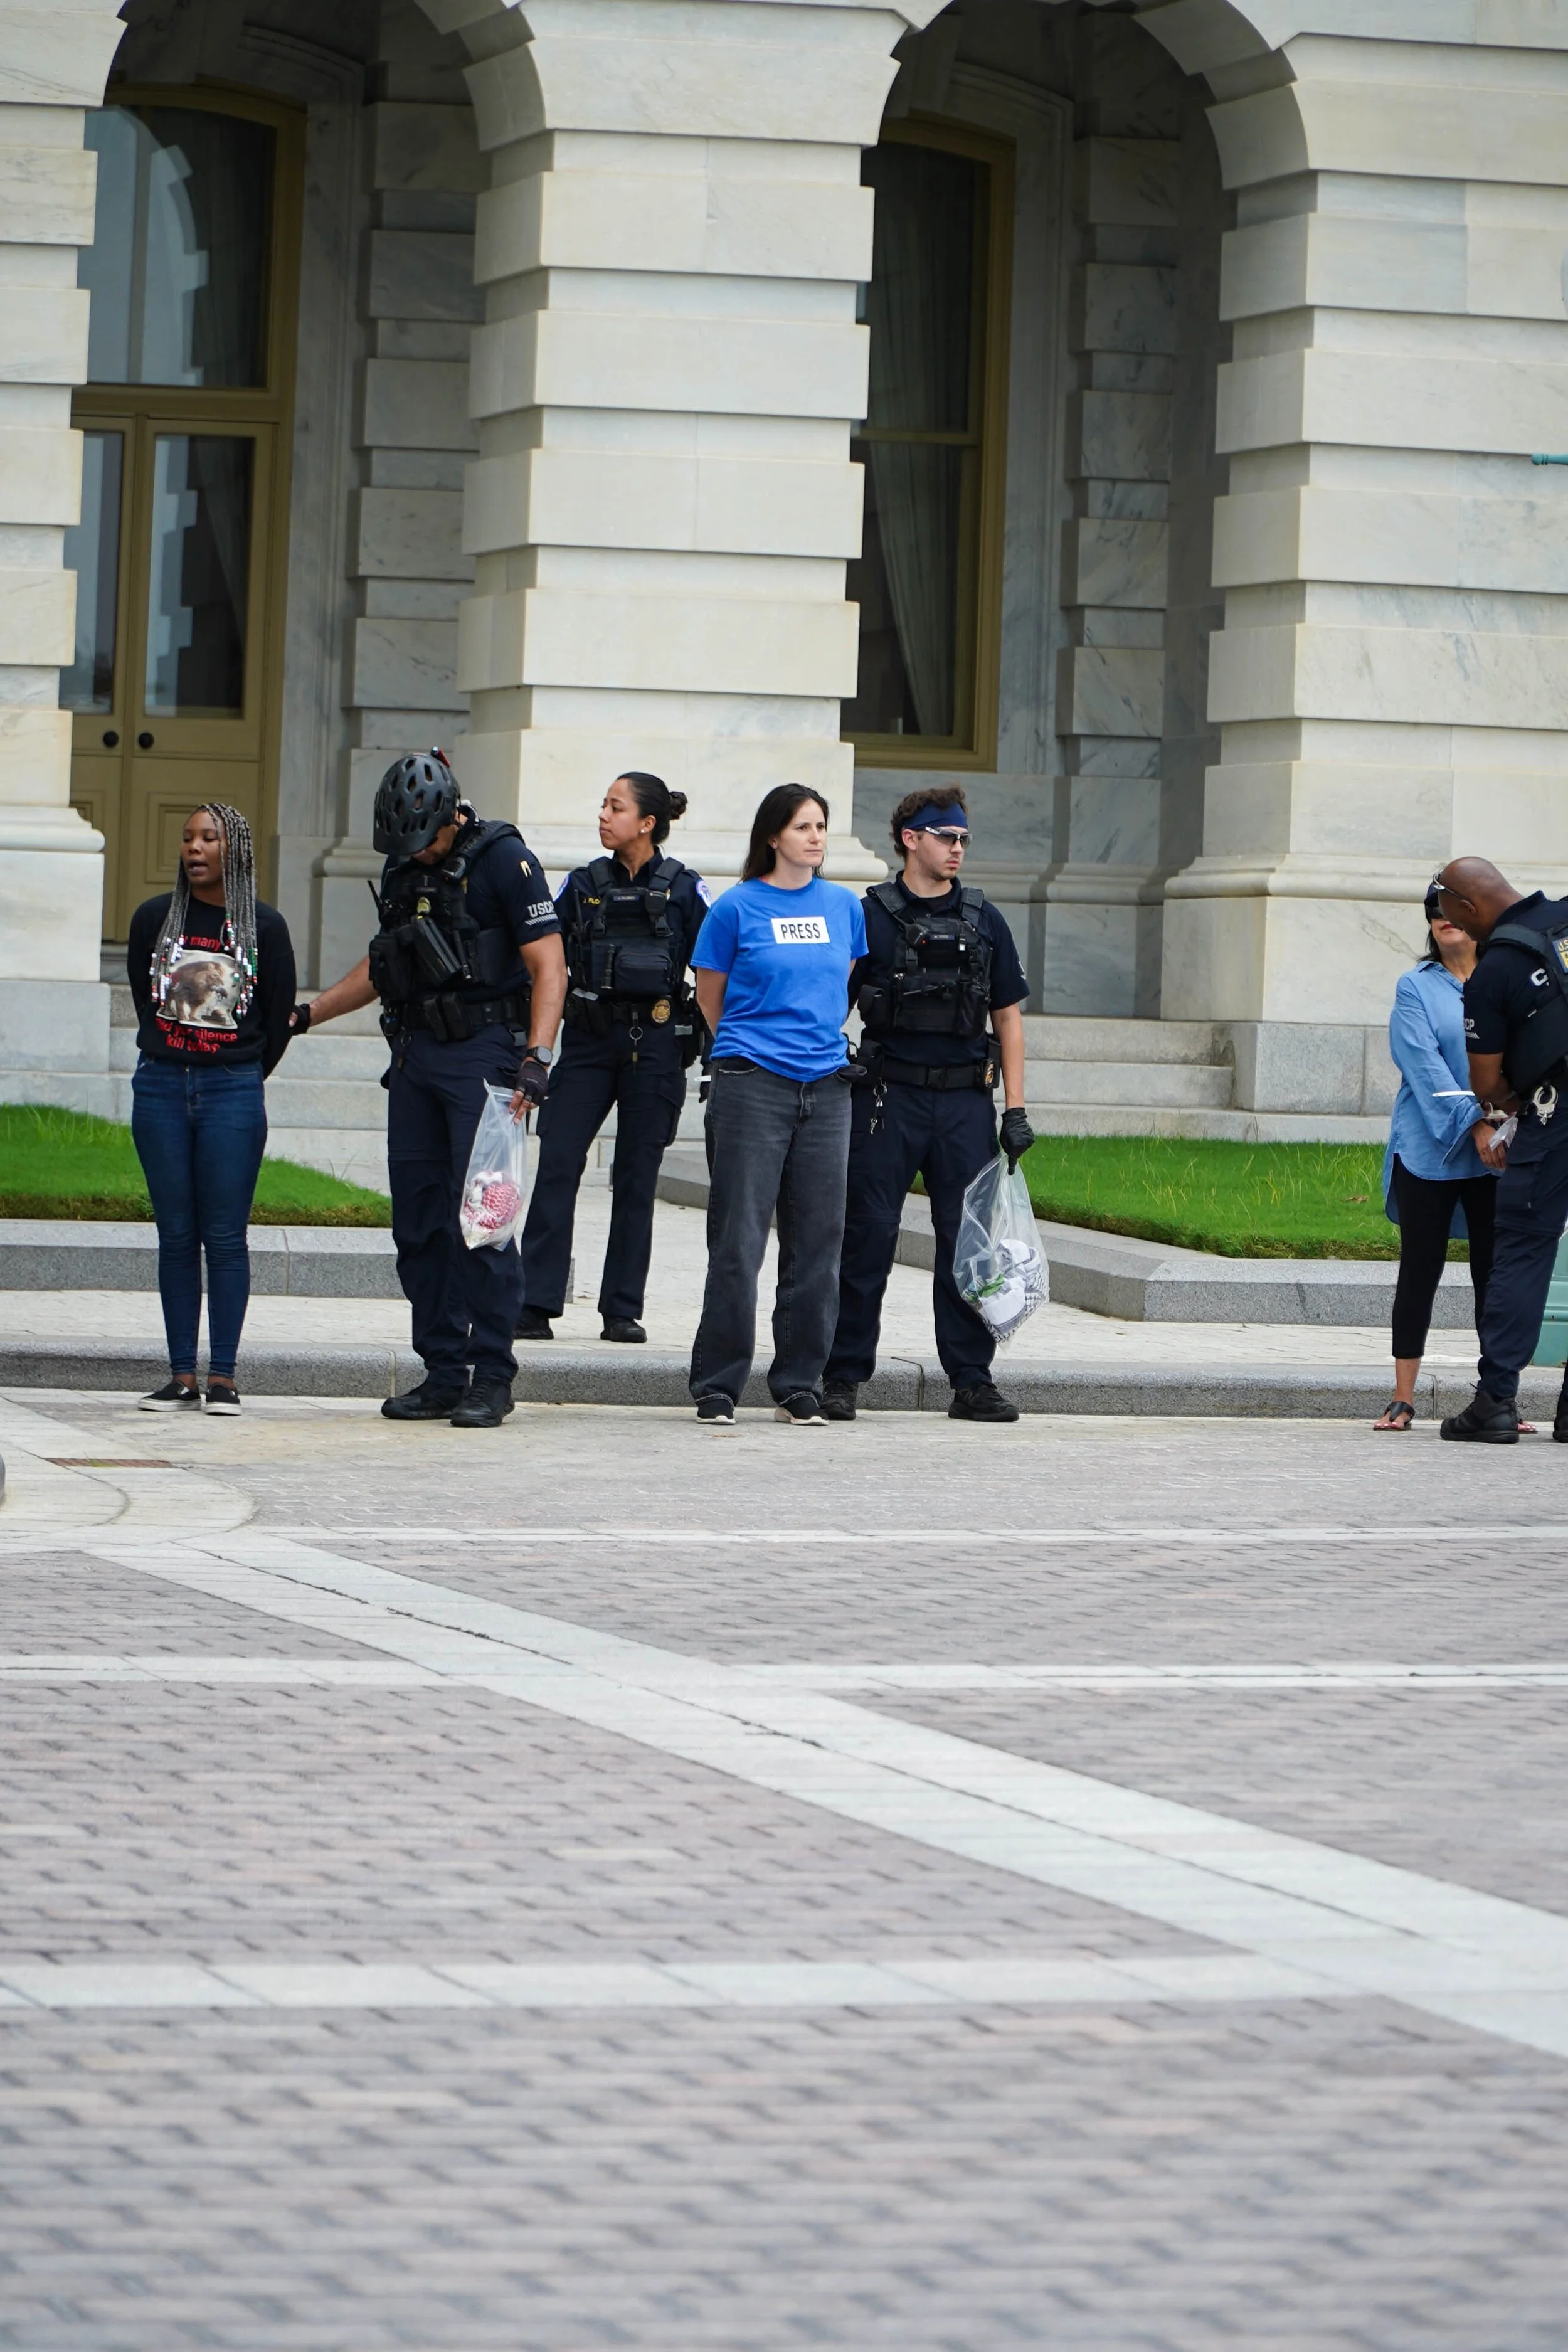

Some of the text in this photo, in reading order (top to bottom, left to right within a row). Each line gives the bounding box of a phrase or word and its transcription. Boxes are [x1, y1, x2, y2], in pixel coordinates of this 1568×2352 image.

[780, 923, 820, 939] PRESS
[189, 936, 221, 952] many
[1465, 1018, 1475, 1030] CP
[166, 1034, 185, 1049] kill
[195, 1029, 238, 1042] silence
